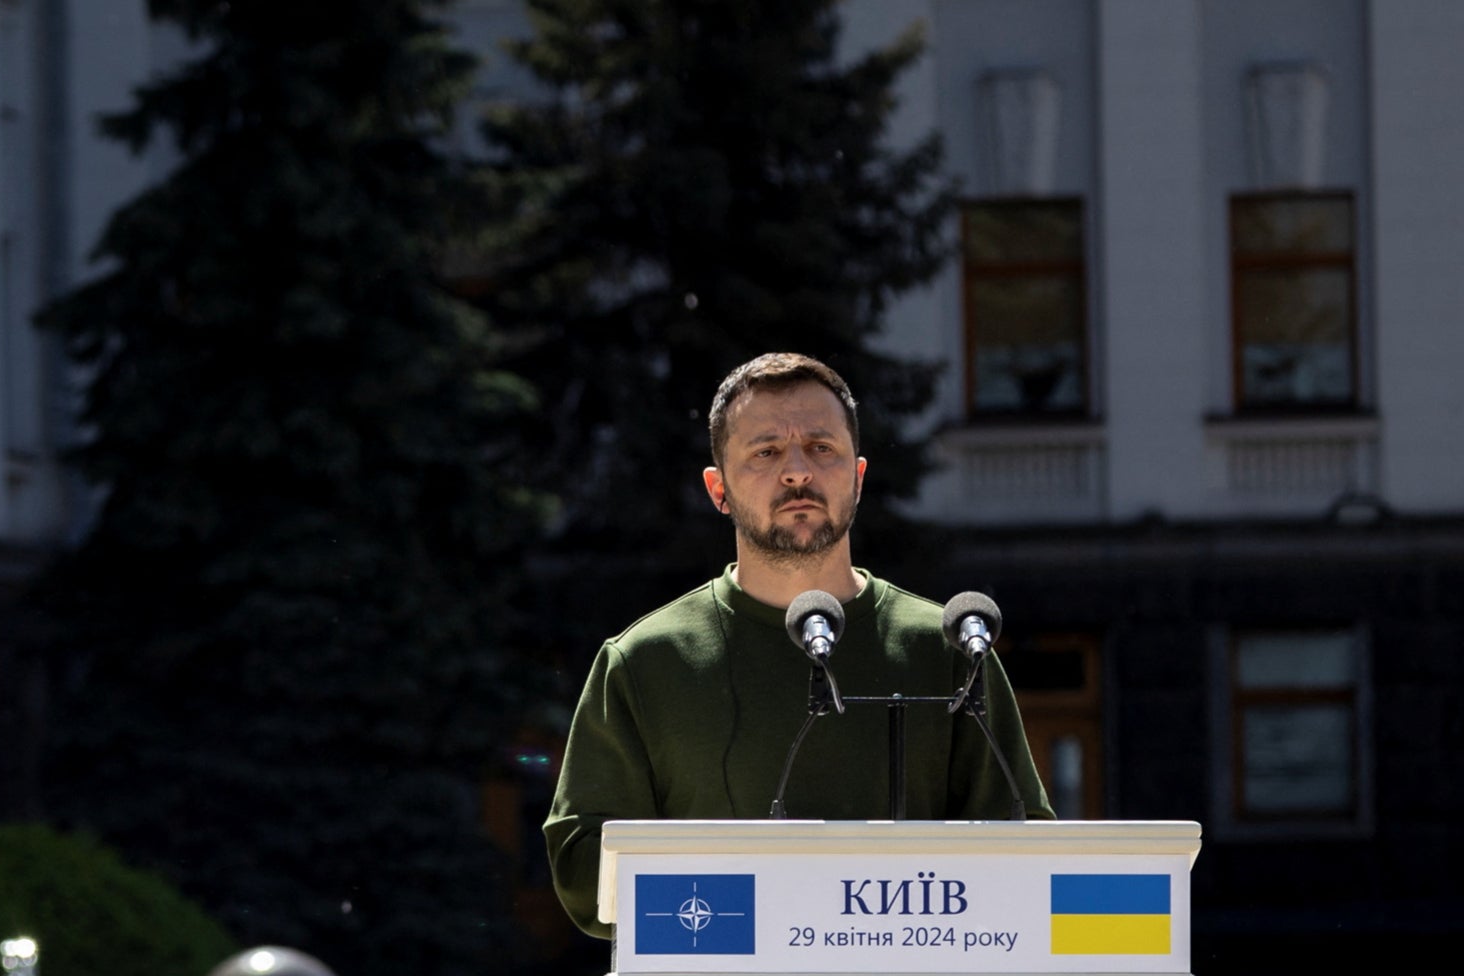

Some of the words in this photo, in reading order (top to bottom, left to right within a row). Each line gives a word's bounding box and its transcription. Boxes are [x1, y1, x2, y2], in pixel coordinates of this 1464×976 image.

[840, 871, 968, 915] КИЇВ
[788, 926, 815, 947] 29
[823, 926, 893, 947] квітня
[901, 926, 956, 947] 2024
[963, 930, 1018, 952] року
